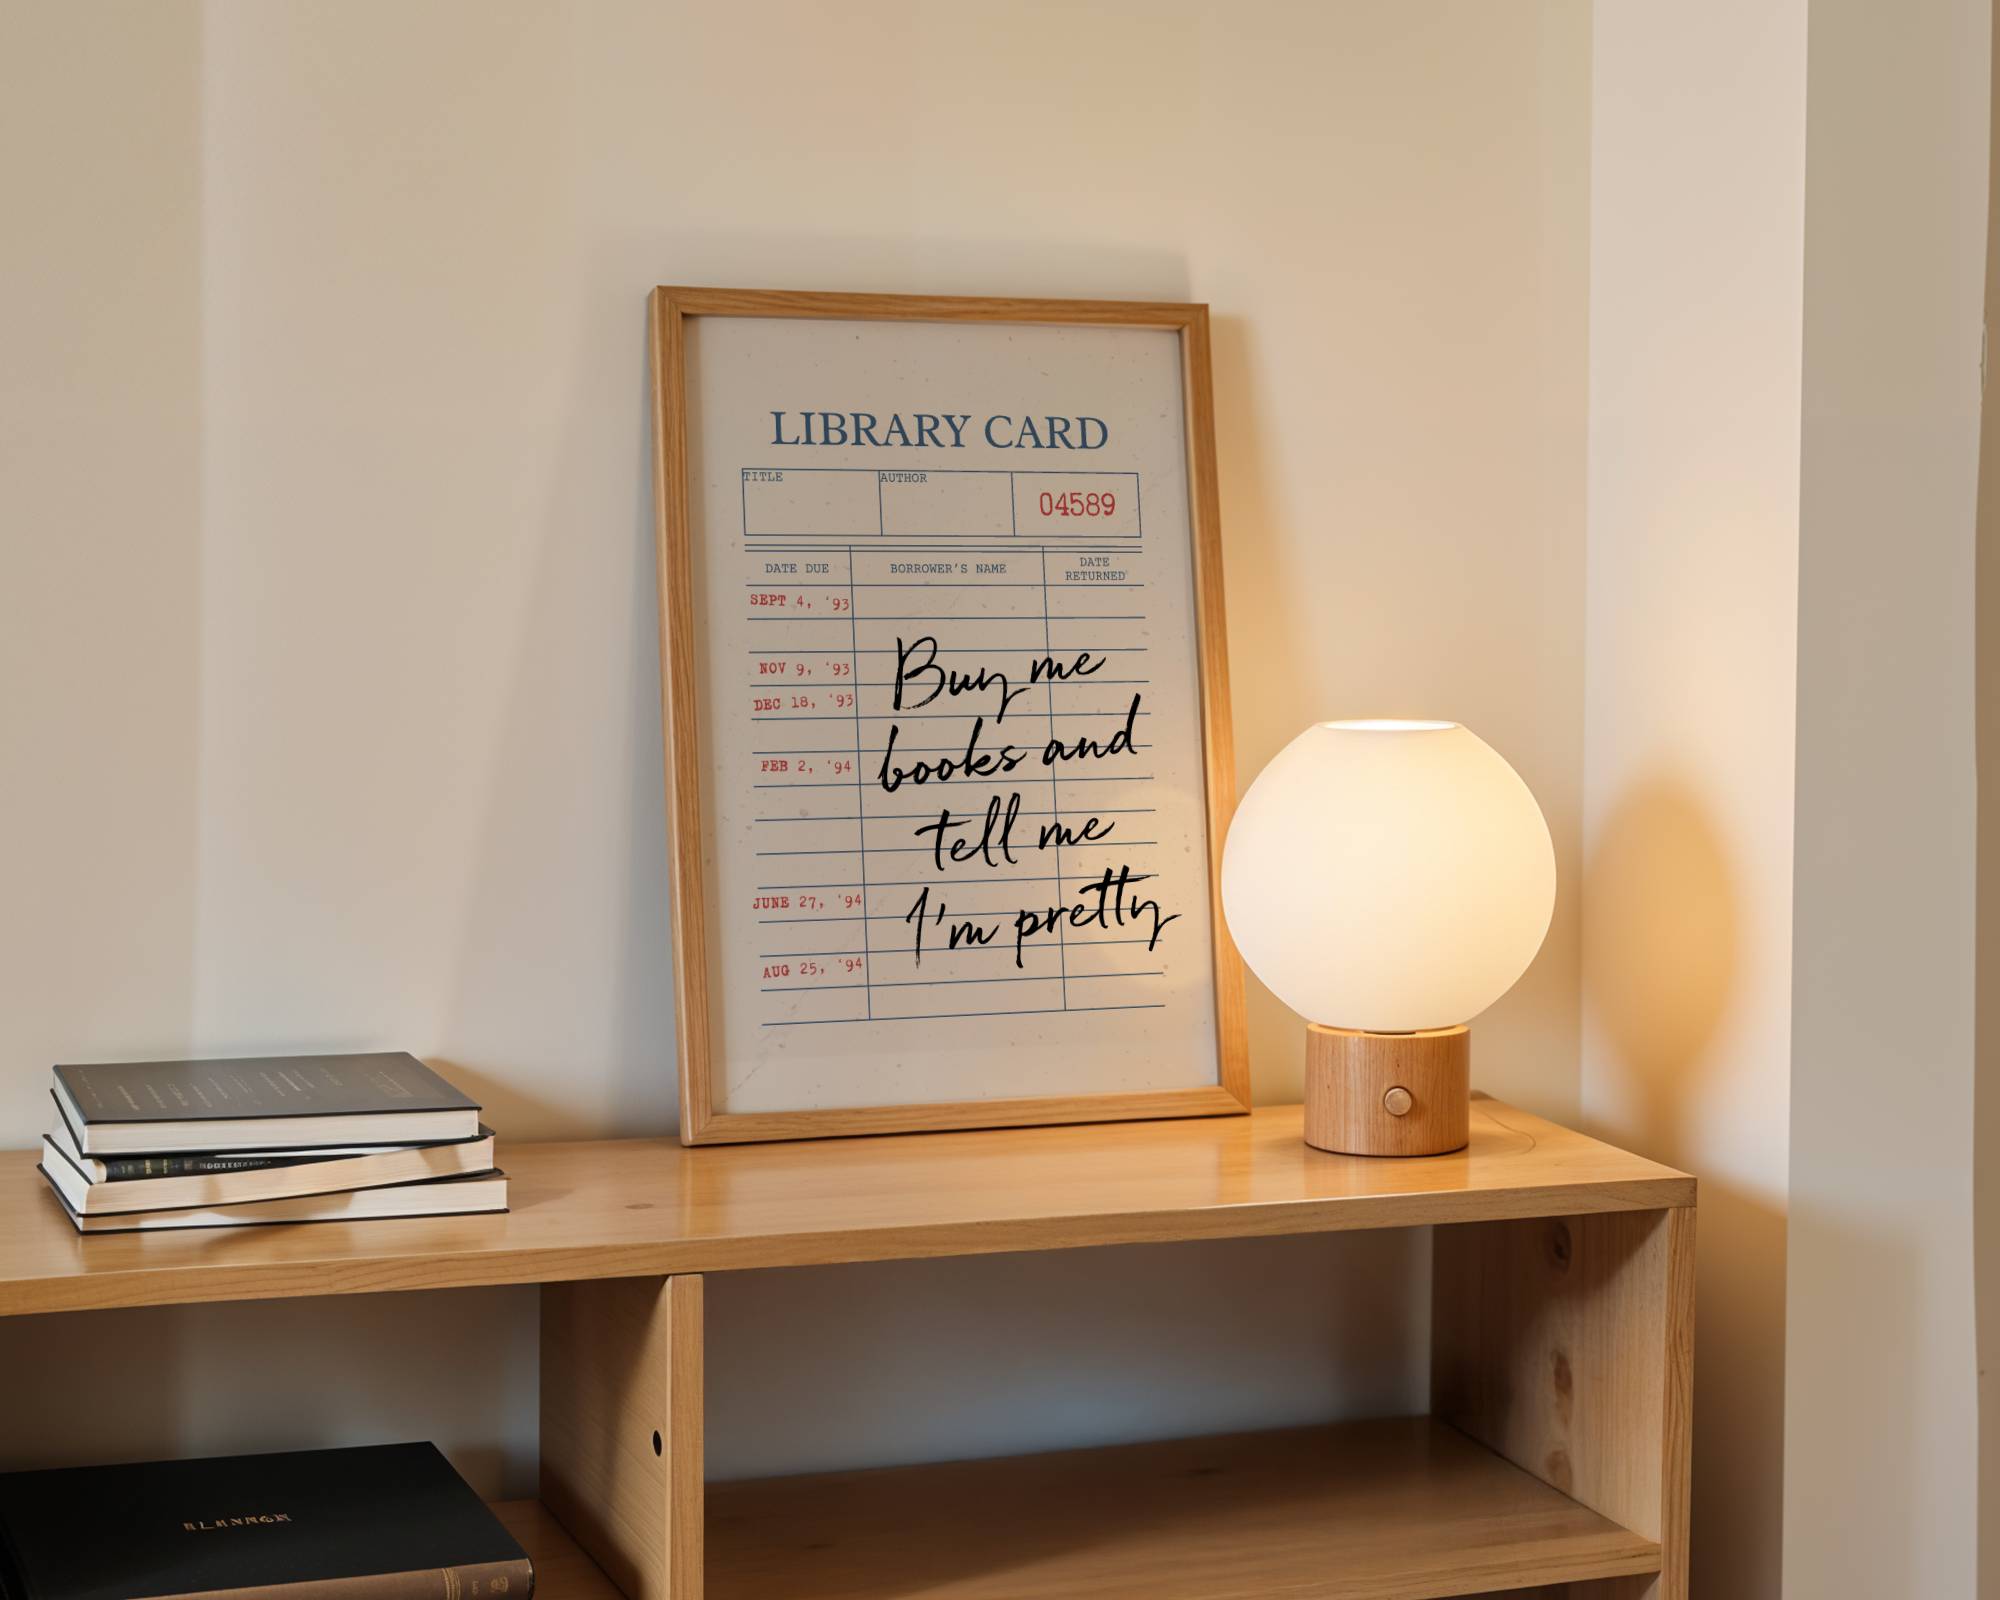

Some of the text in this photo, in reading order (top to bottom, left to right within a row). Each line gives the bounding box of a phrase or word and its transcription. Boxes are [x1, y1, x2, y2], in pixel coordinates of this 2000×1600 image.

[770, 411, 1109, 450] LIBRARY CARD
[743, 471, 783, 482] TITLE
[880, 473, 928, 484] AUTHOR
[1039, 492, 1116, 517] 04589
[765, 564, 829, 574] DATE DUE
[890, 563, 1007, 574] BORROWER'S NAME
[1080, 557, 1110, 567] DATE
[1065, 570, 1126, 582] RETURNED
[750, 594, 850, 611] SEPT 4, '93
[759, 662, 850, 676] NOV 9, '93
[893, 636, 1106, 724] Buy me
[754, 694, 853, 712] DEC 18, '93
[878, 693, 1141, 793] books and
[761, 760, 852, 774] FEB 2, '94
[914, 792, 1115, 872] tell me
[752, 894, 861, 910] JUNE 27, '94
[905, 865, 1182, 969] I'm pretty
[763, 957, 862, 979] AUG 25, '94
